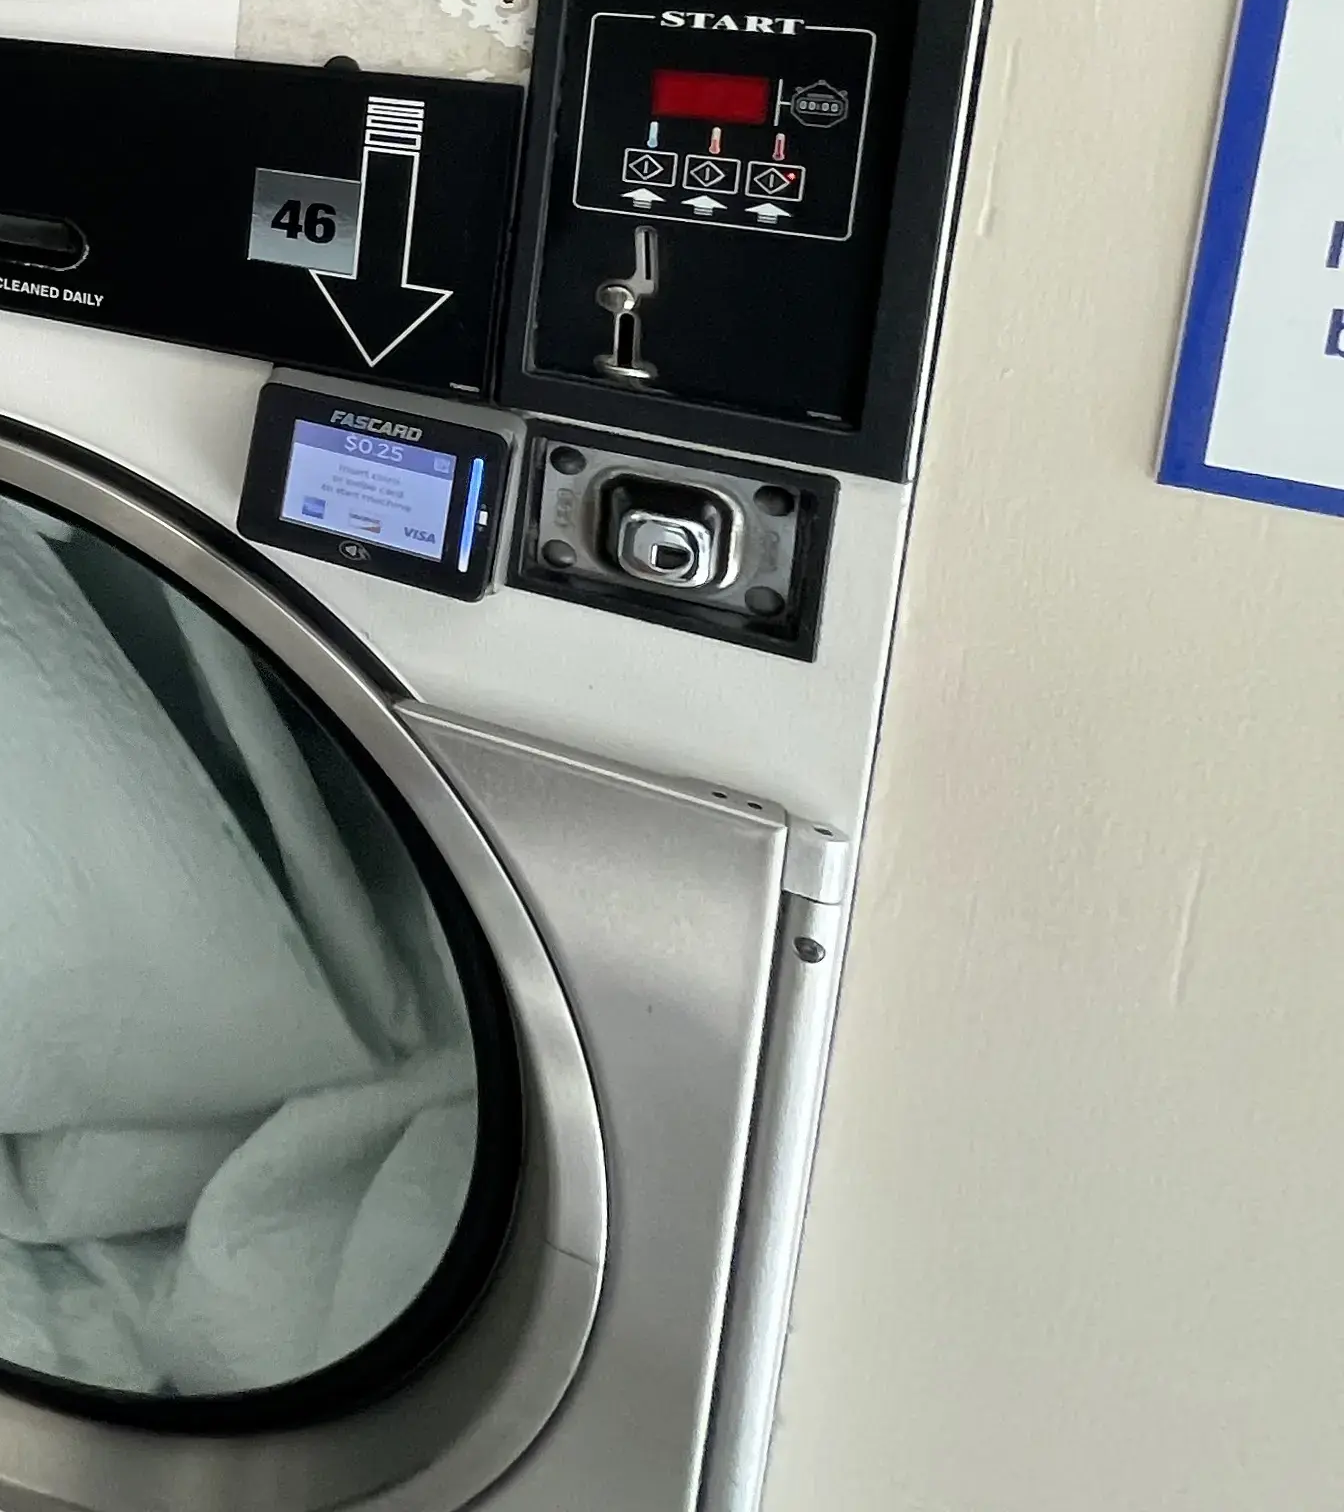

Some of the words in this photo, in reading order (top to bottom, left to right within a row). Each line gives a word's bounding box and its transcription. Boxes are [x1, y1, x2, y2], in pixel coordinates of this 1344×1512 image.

[660, 10, 805, 36] START
[270, 199, 336, 244] 46
[63, 289, 104, 307] DAILY
[330, 409, 423, 441] FASCARD
[404, 527, 436, 544] VISA
